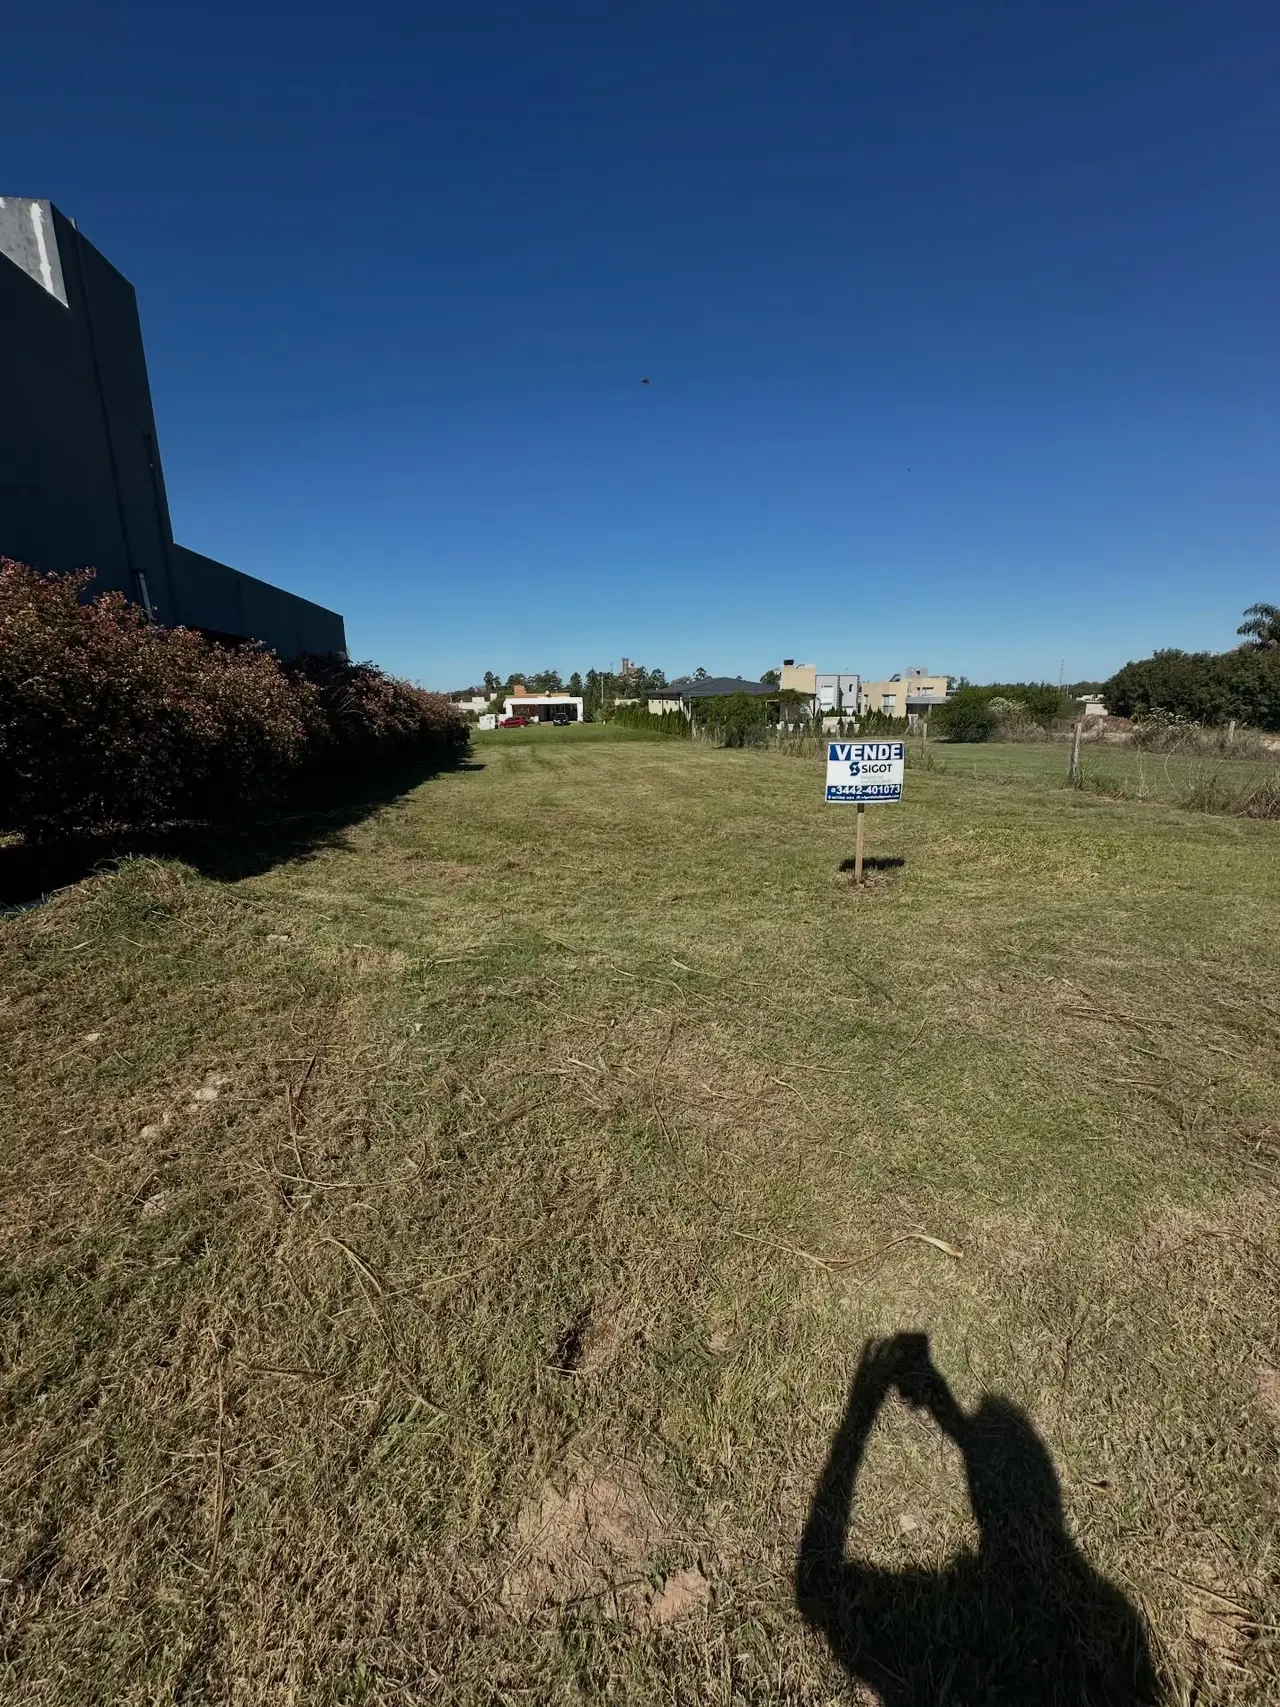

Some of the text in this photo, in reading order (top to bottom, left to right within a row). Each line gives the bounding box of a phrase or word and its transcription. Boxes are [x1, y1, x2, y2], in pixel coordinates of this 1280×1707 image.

[835, 744, 900, 760] VENDE
[861, 764, 892, 773] SIGOT
[836, 785, 900, 794] 3442-401073
